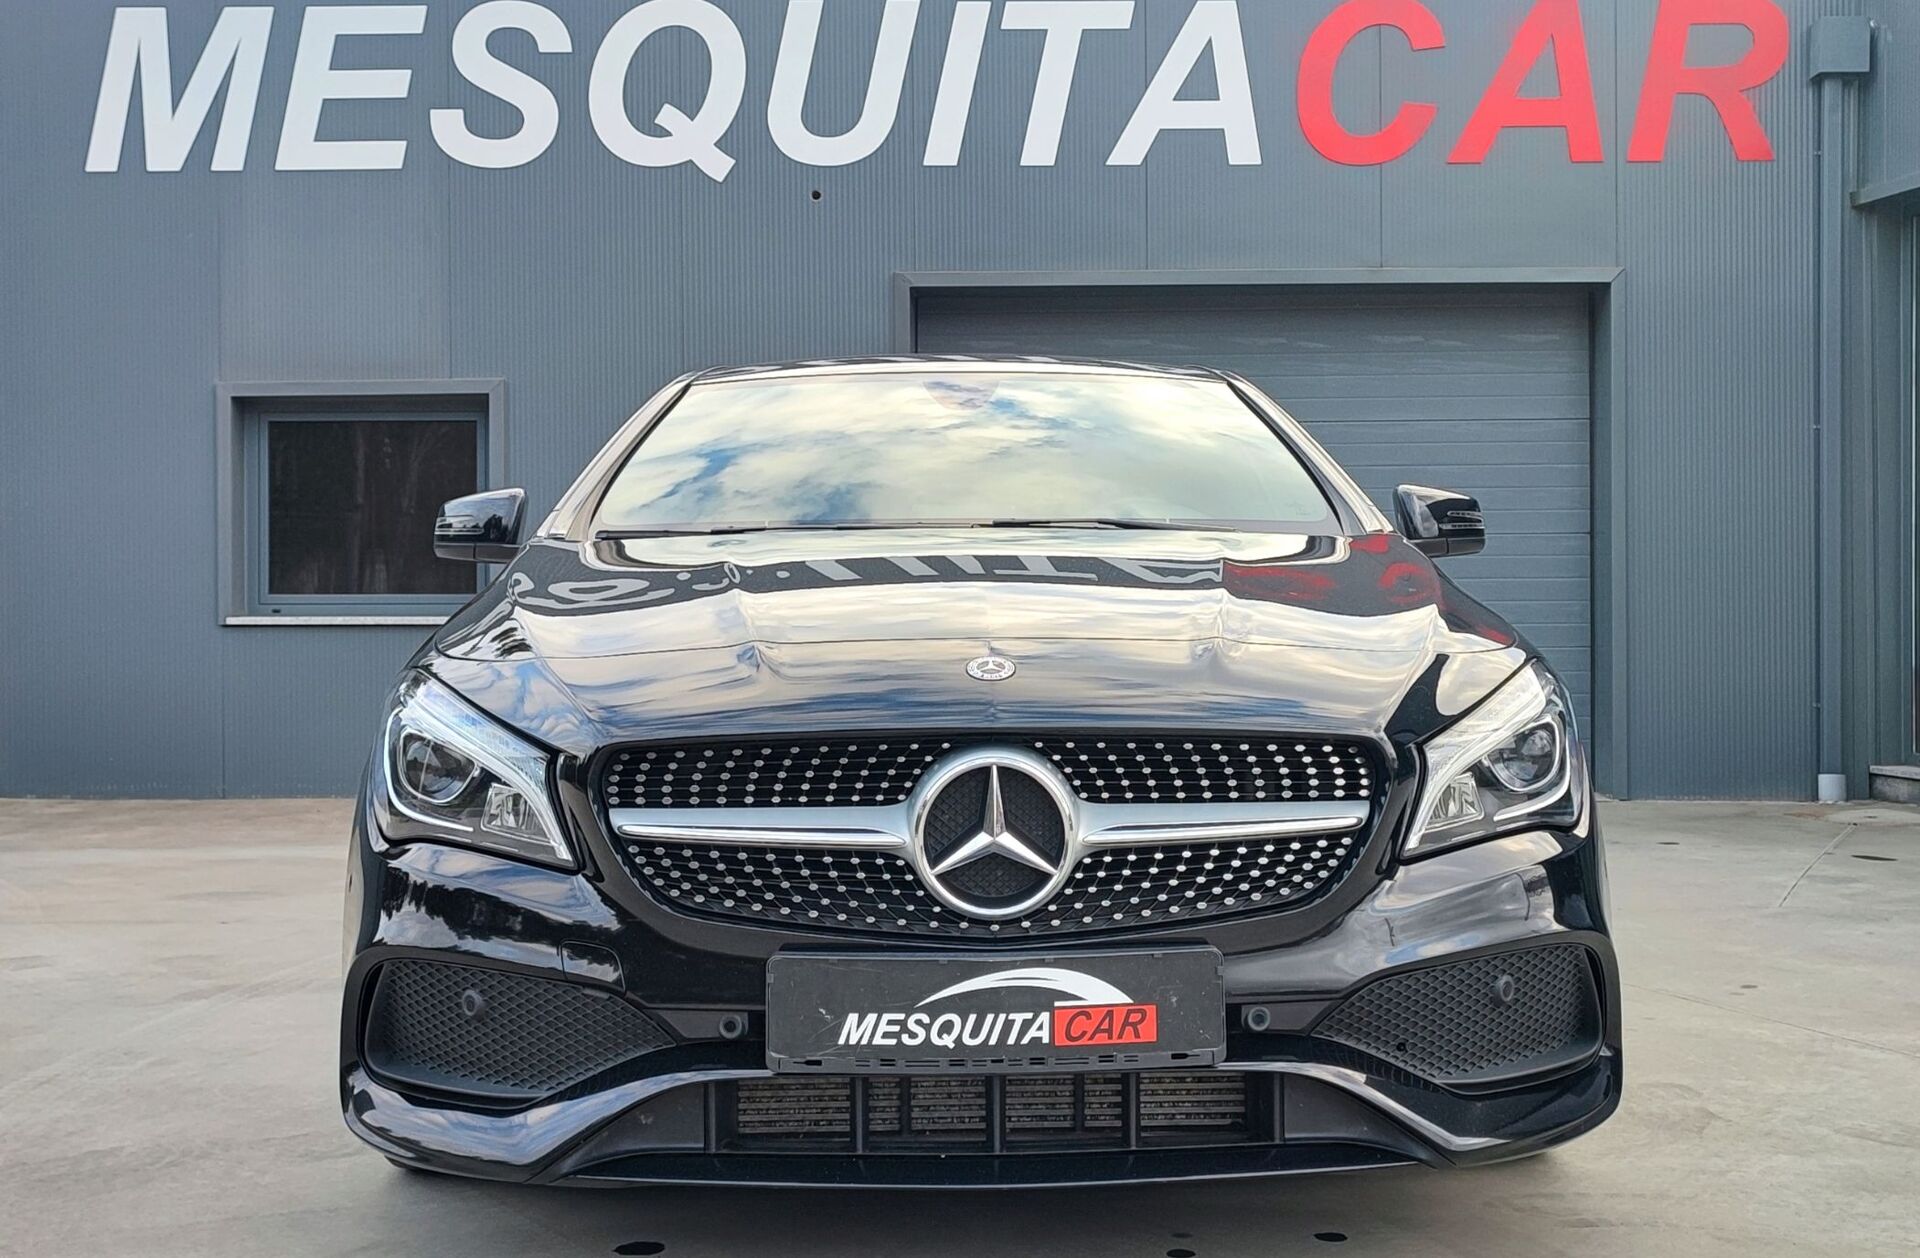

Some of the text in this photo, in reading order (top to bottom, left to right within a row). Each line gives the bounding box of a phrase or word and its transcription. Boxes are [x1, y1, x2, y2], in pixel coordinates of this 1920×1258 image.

[85, 0, 1789, 182] MESQUITA CAR
[838, 1008, 1147, 1048] MESQUITA CAR
